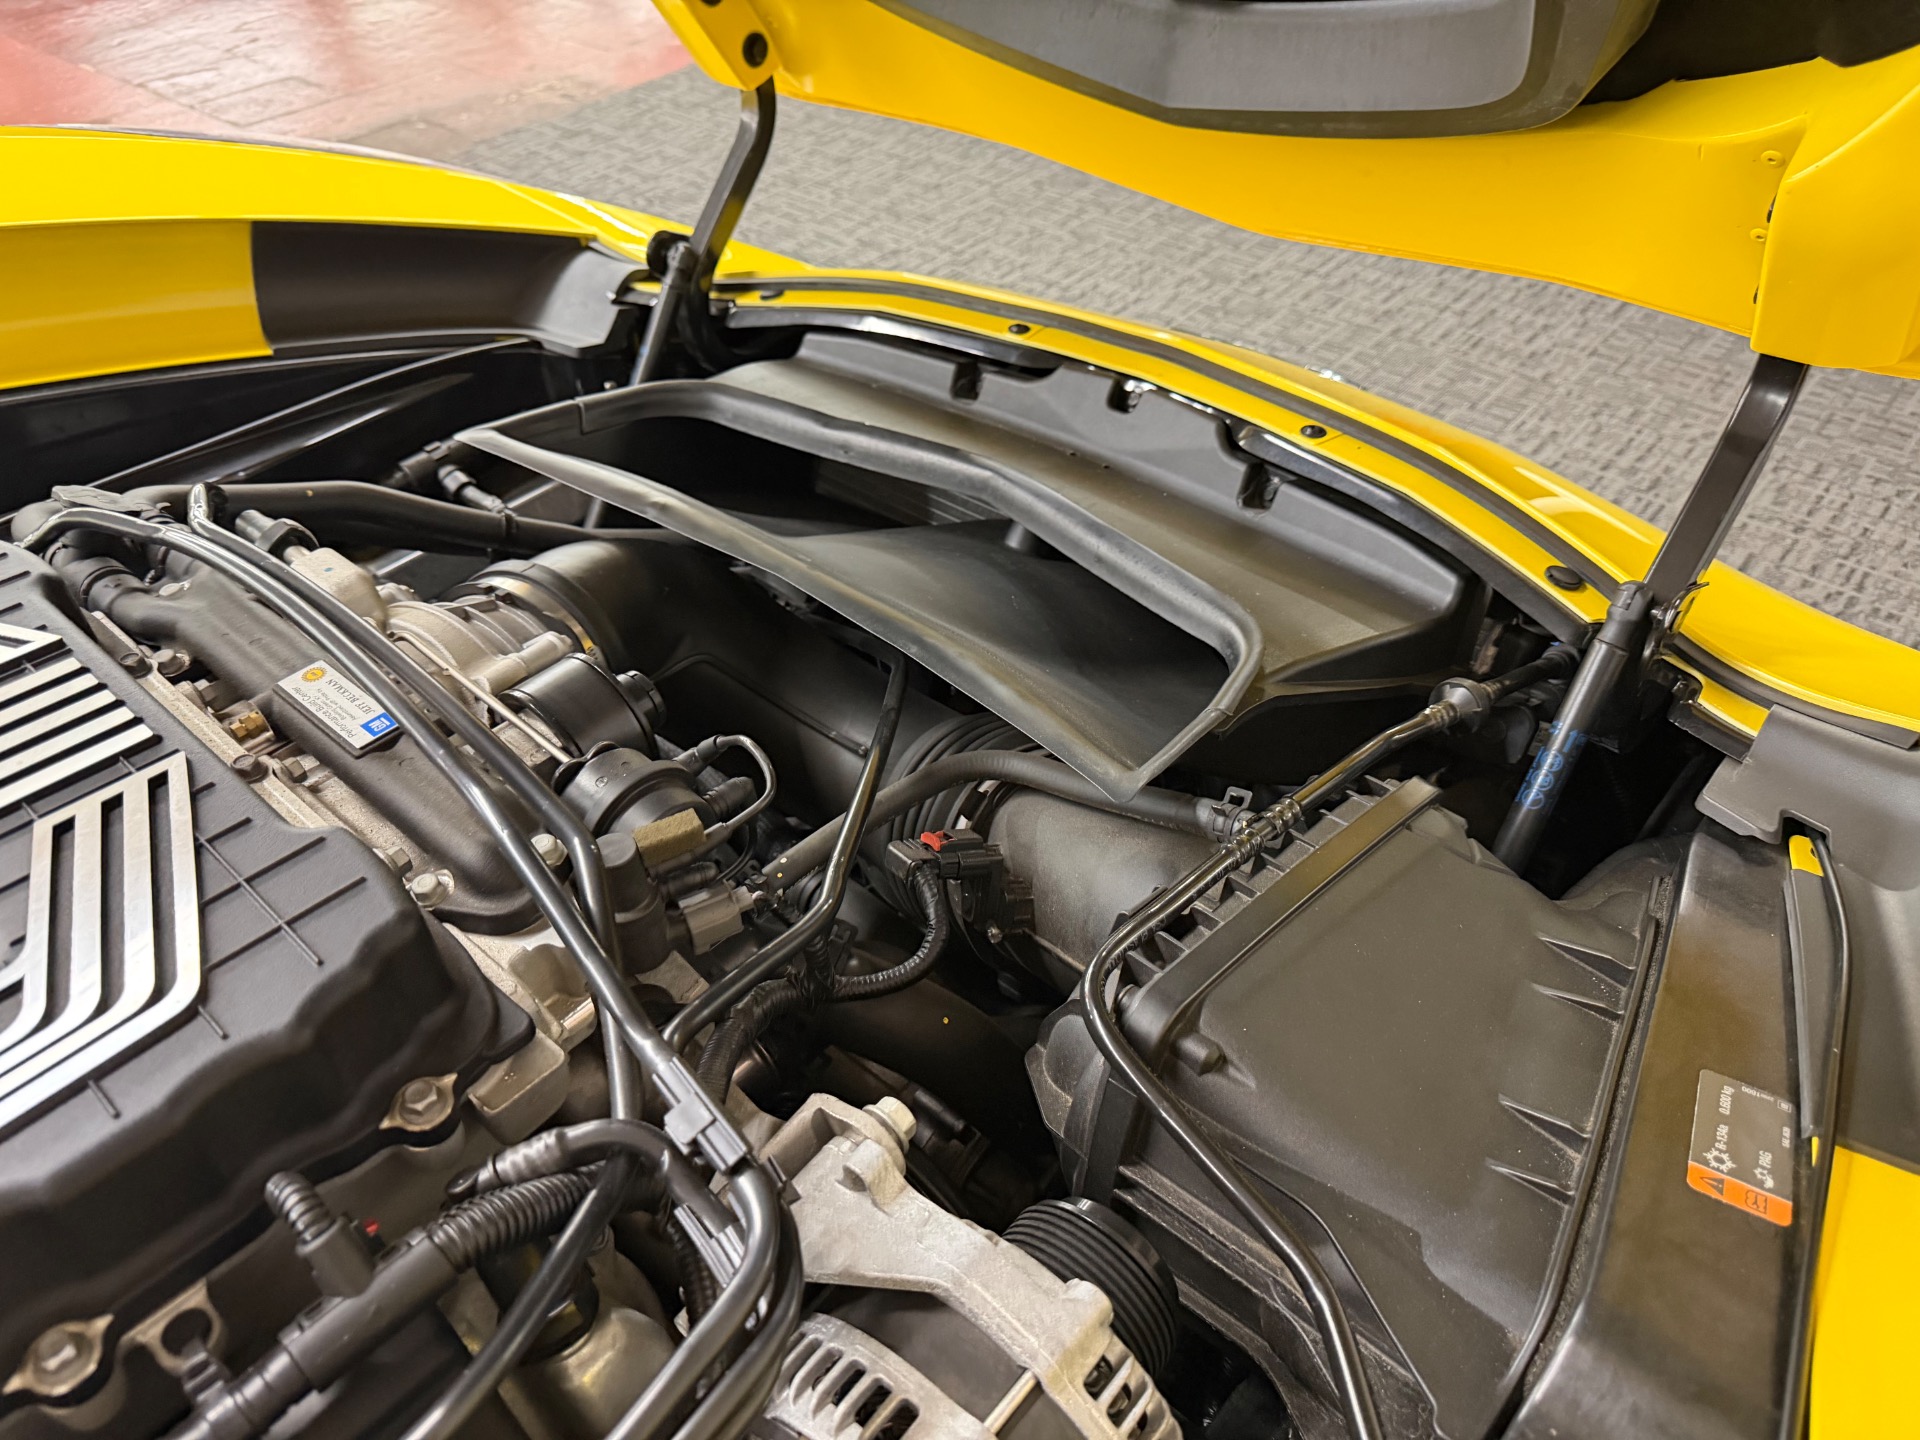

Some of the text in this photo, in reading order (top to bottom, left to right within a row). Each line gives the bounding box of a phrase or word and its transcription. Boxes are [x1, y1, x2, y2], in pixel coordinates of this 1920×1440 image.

[291, 686, 357, 738] Performance Build Center
[326, 678, 375, 715] JEFF BECKMAN
[368, 720, 387, 731] GM
[1715, 1124, 1728, 1151] R-134a
[1722, 1085, 1734, 1094] kg
[1759, 1151, 1771, 1168] PAG
